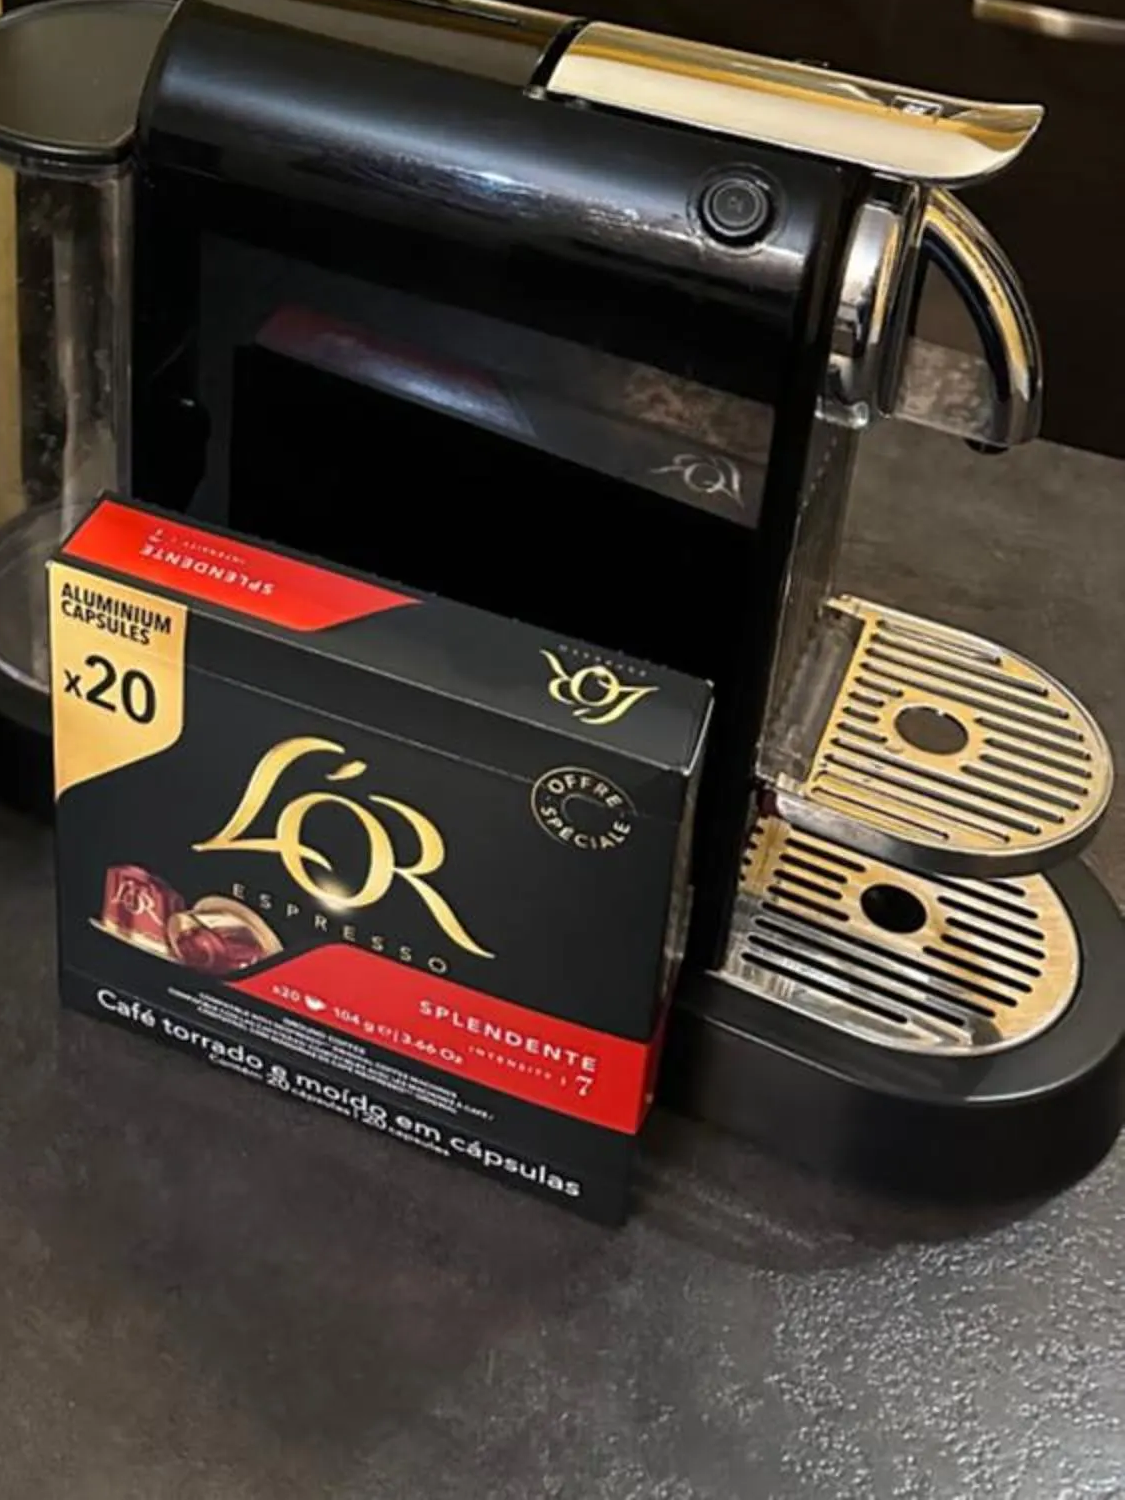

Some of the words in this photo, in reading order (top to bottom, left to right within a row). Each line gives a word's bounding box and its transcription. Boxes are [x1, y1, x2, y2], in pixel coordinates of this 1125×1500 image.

[139, 543, 275, 596] SPLENDENTE
[61, 583, 171, 635] ALUMINIUM
[62, 600, 150, 645] CAPSULES
[64, 654, 156, 724] x20
[547, 773, 623, 808] OFFRE
[233, 883, 447, 975] ESPRESSO
[419, 1000, 598, 1072] SPLENDENTE
[97, 988, 156, 1027] Café
[162, 1018, 263, 1070] torrado
[295, 1072, 387, 1121] moído
[395, 1113, 442, 1143] em
[449, 1135, 581, 1197] cápsulas
[575, 1075, 594, 1097] 7
